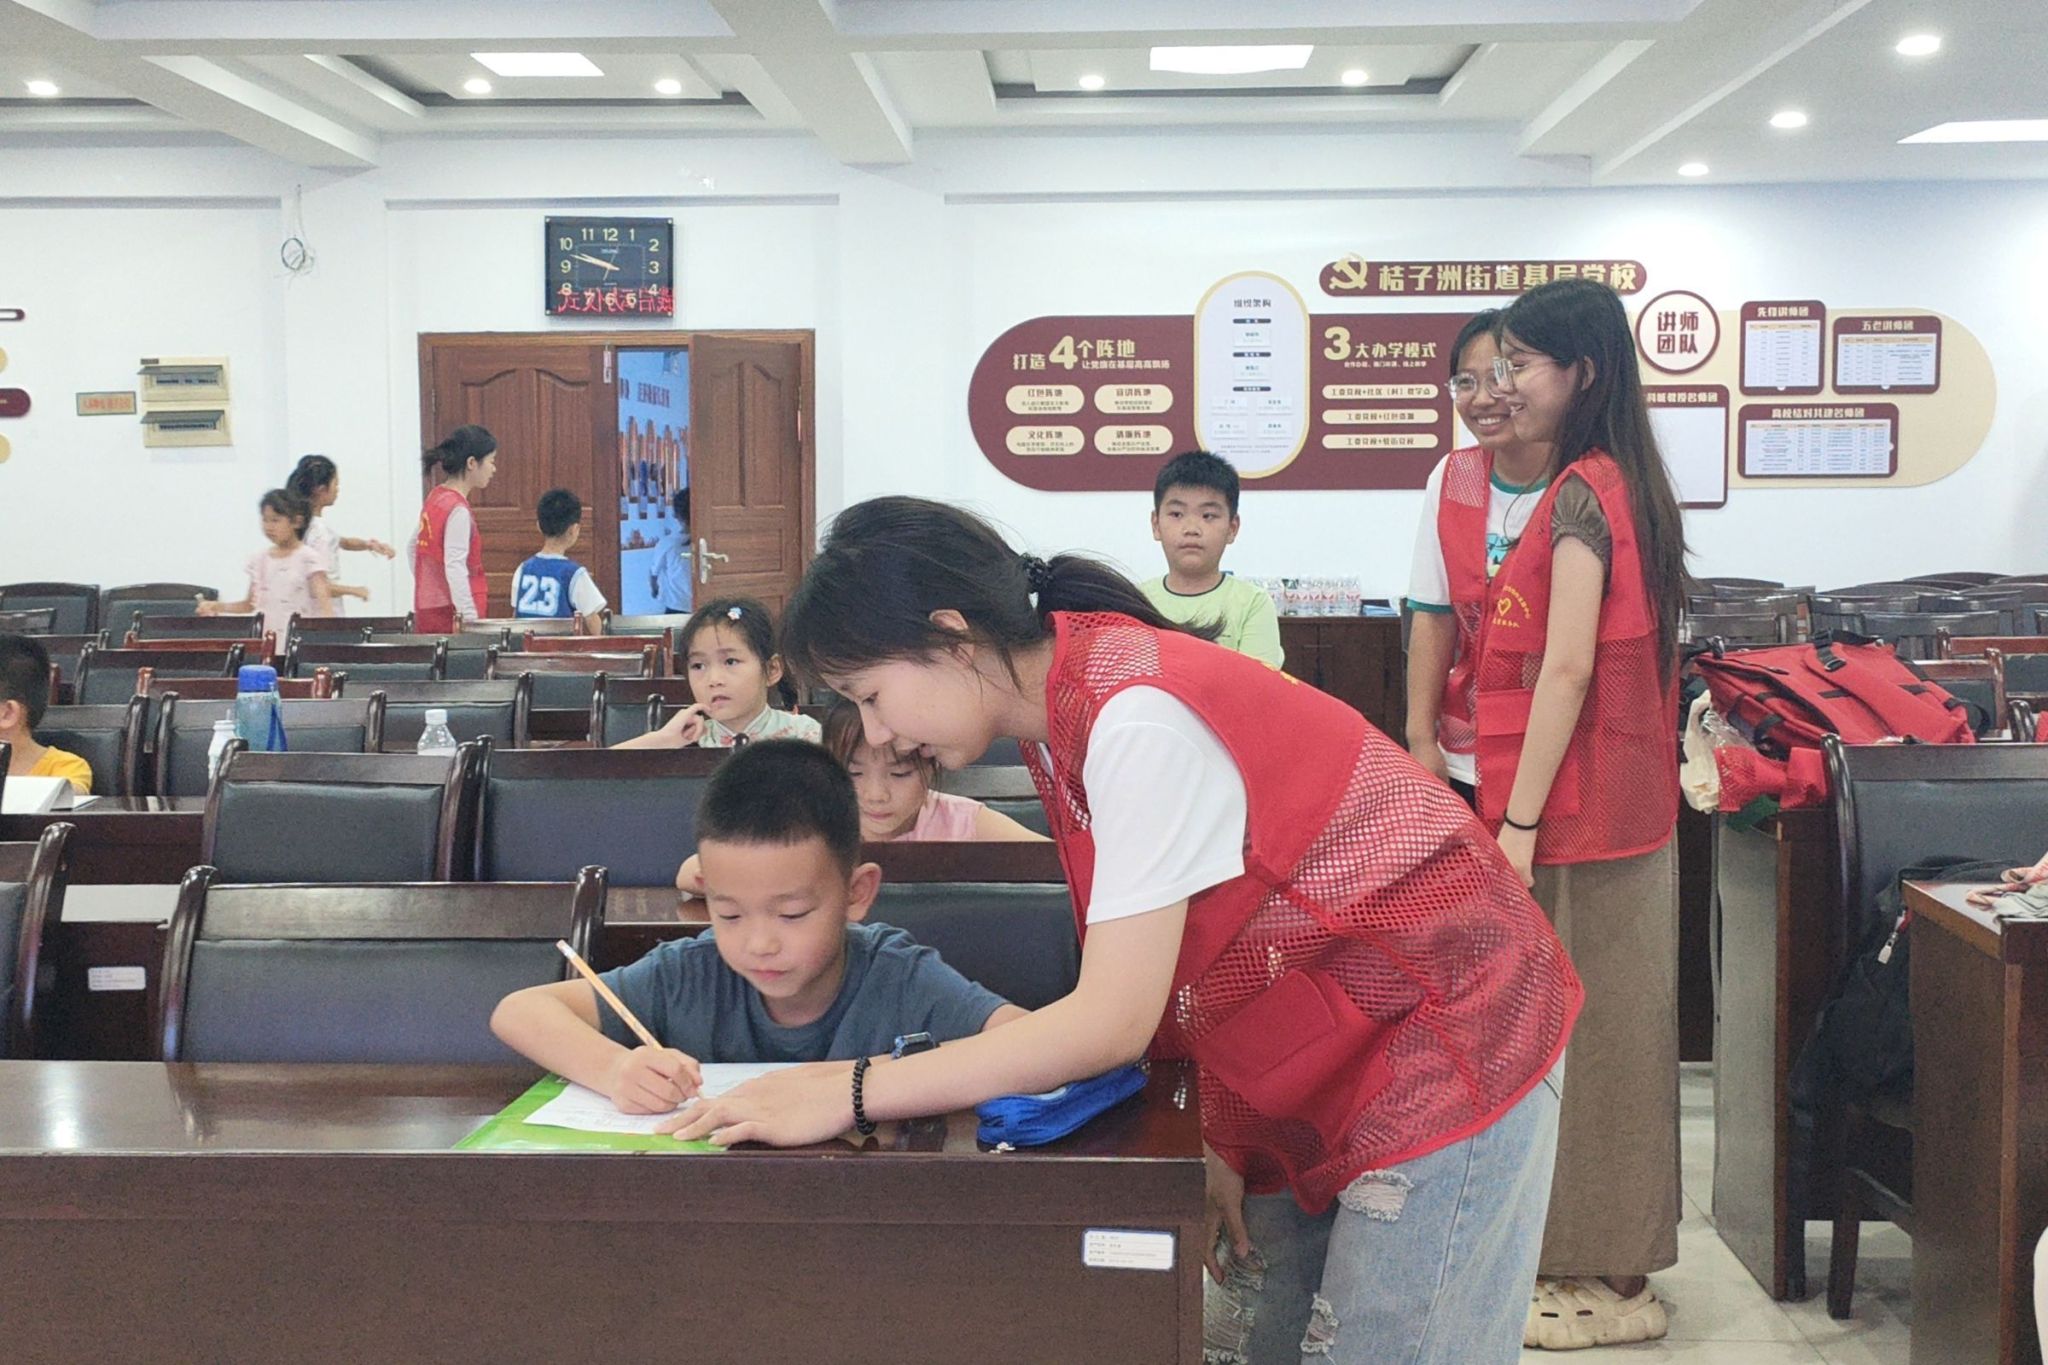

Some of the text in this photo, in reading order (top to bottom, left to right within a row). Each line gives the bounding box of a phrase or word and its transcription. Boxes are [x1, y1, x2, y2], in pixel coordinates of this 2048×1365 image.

[582, 228, 594, 241] 11
[603, 228, 618, 241] 12
[629, 228, 635, 241] 1
[560, 237, 573, 251] 10
[648, 239, 659, 252] 2
[560, 260, 571, 273] 9
[649, 261, 660, 274] 3
[561, 282, 572, 295] 8
[648, 284, 659, 296] 4
[584, 291, 595, 304] 7
[605, 293, 616, 306] 6
[625, 293, 637, 308] 5
[1657, 311, 1699, 331] 讲师
[1657, 333, 1698, 354] 团队
[518, 575, 560, 616] 23
